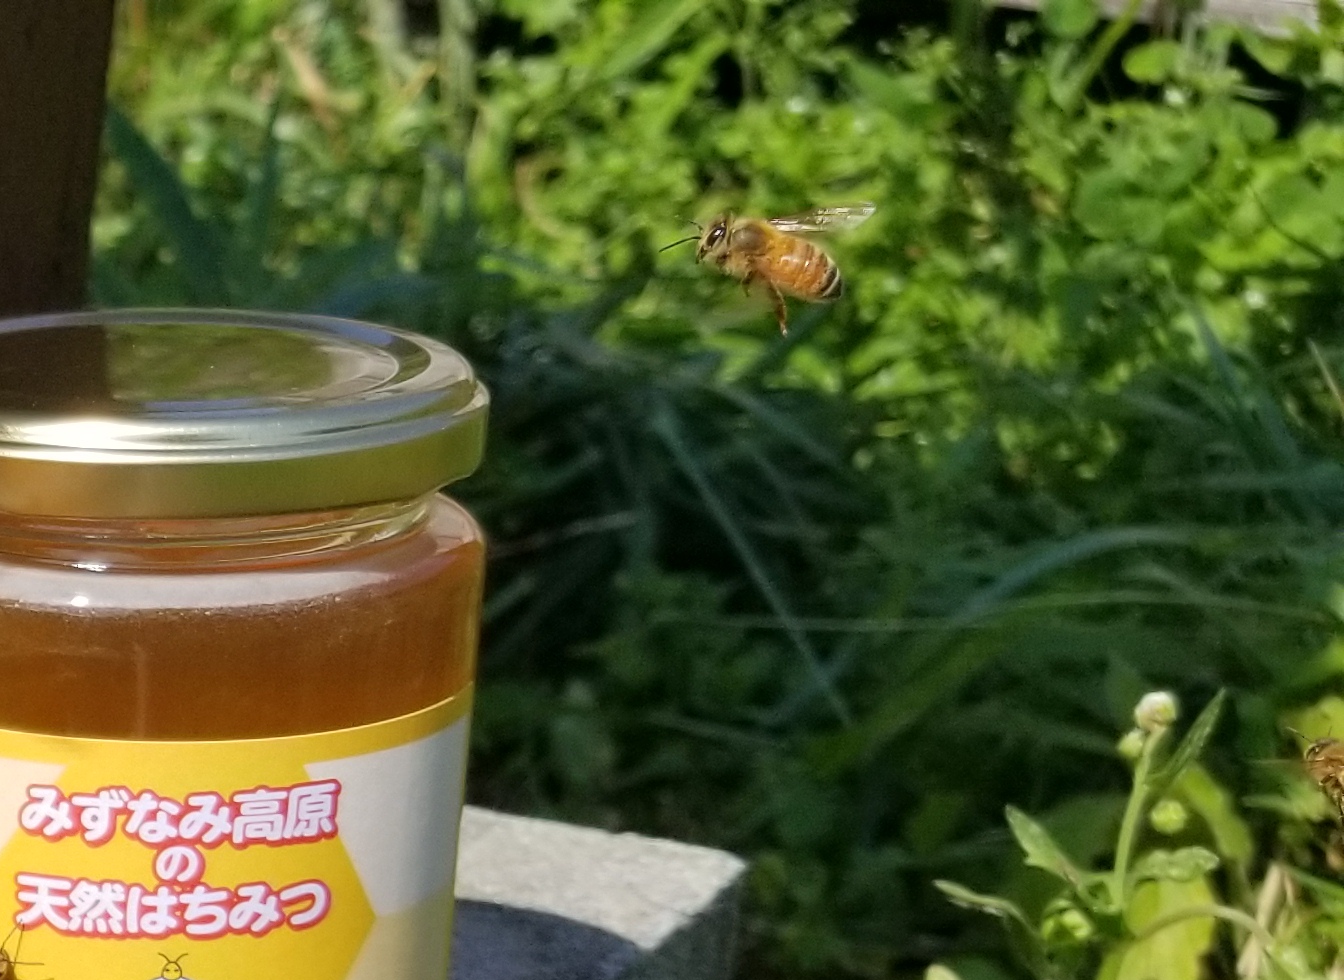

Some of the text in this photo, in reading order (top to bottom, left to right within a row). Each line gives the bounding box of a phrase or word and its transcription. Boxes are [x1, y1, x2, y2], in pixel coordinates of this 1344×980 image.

[17, 780, 340, 847] みずなみ高原
[153, 844, 202, 885] の
[13, 872, 331, 939] 天然はちみつ
